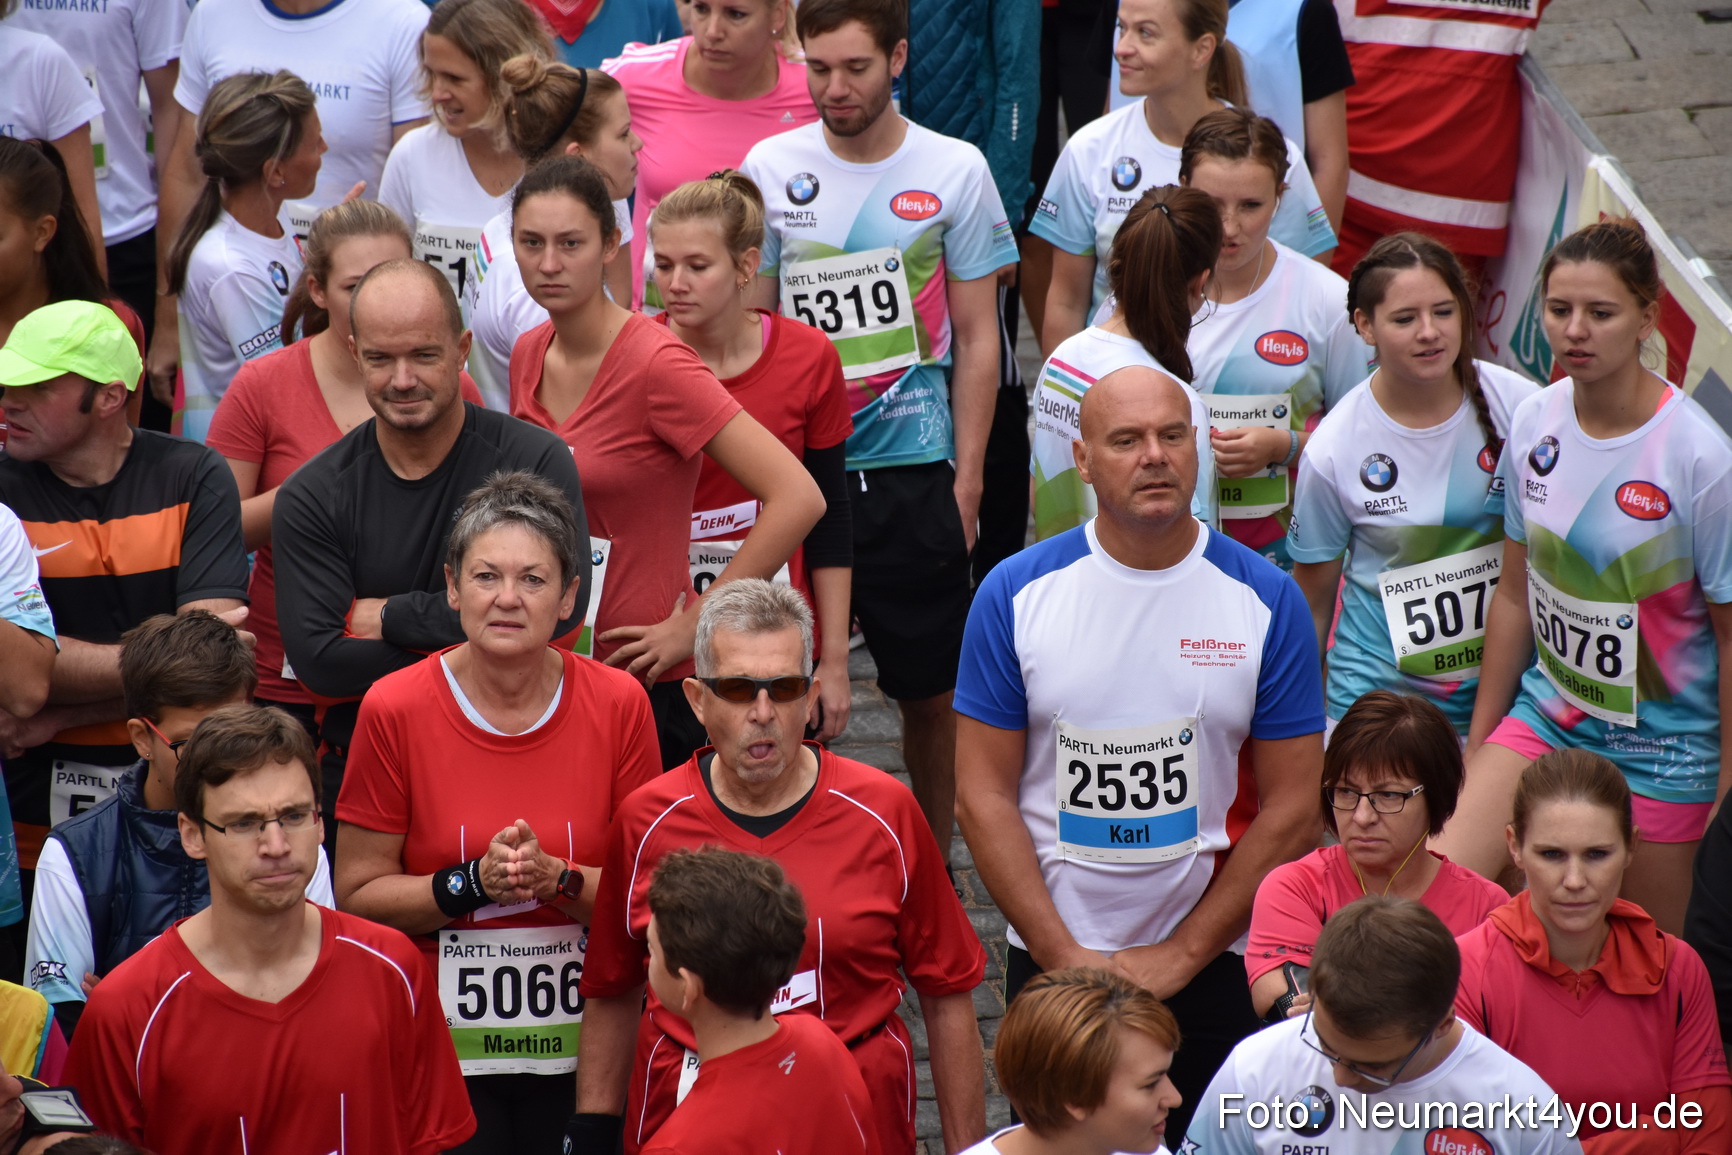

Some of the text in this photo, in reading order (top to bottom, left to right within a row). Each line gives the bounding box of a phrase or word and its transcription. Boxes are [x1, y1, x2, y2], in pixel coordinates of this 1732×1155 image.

[24, 0, 108, 13] NEUMARKT
[897, 198, 936, 213] Hervis
[783, 211, 817, 221] PARTL
[818, 263, 880, 283] Neumarkt
[792, 280, 900, 334] 5319
[1262, 338, 1304, 358] Hervis
[1526, 479, 1548, 497] PARTL
[1364, 495, 1407, 511] PARTL
[1622, 486, 1665, 512] Hervis
[1367, 505, 1409, 517] Neumarkt
[700, 513, 736, 531] DEHN
[1385, 558, 1499, 597] PARTL Neumarkt
[1528, 572, 1611, 627] PARTL Neumarkt
[1180, 639, 1247, 650] Felßner
[1535, 597, 1622, 678] 5078
[1547, 654, 1605, 704] Elisabeth
[1059, 734, 1174, 756] PARTL Neumarkt
[56, 772, 107, 789] PARTL
[1068, 753, 1188, 811] 2535
[1109, 824, 1150, 844] Karl
[444, 941, 572, 958] PARTL Neumarkt
[457, 961, 586, 1021] 5066
[483, 1034, 563, 1054] Martina
